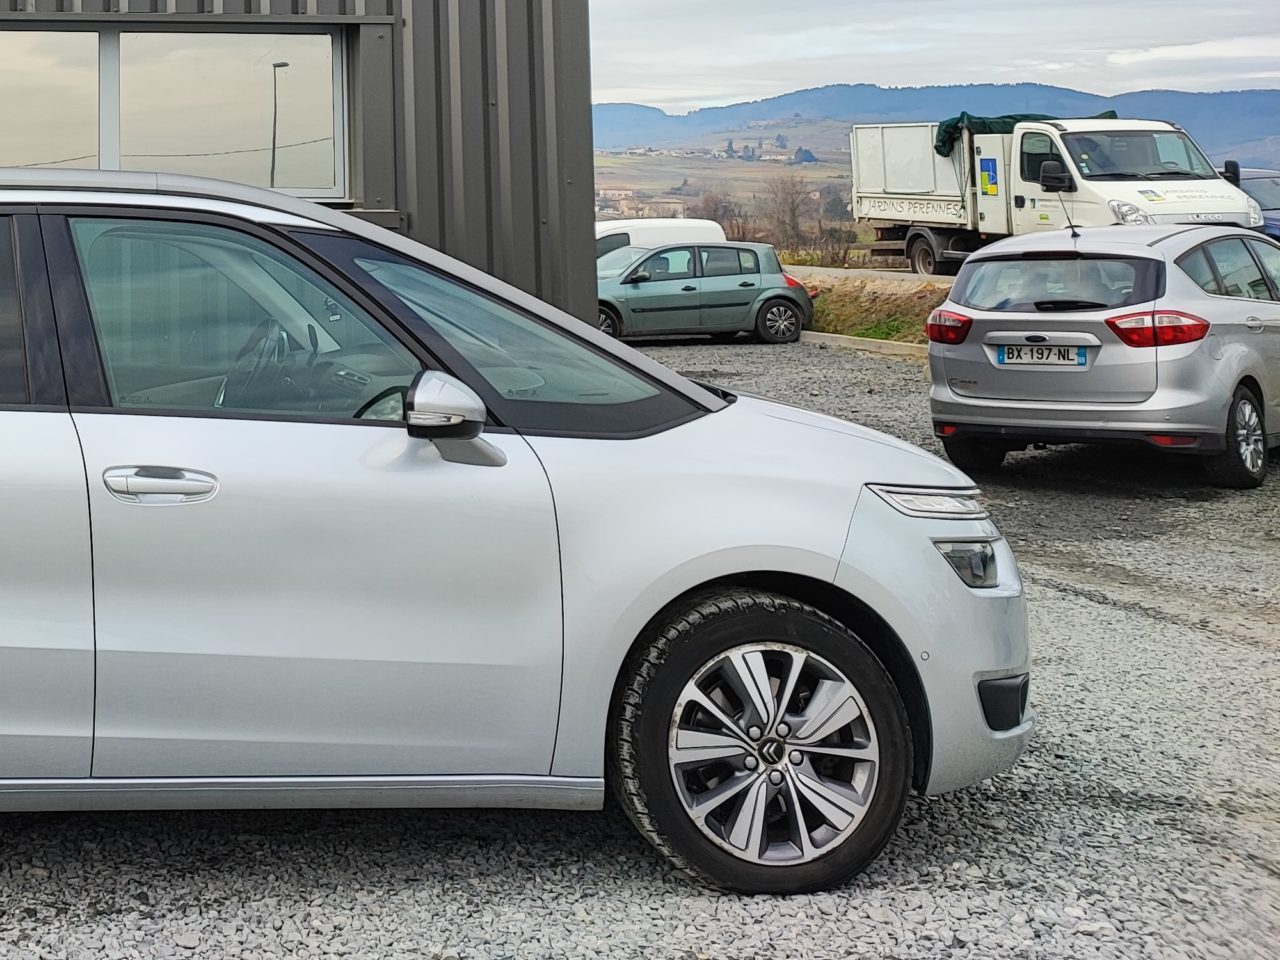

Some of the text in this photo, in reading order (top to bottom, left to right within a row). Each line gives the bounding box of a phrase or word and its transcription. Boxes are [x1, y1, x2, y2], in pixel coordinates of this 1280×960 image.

[864, 199, 959, 217] JARDINS PERENNES
[1188, 213, 1223, 222] IVECO
[1006, 346, 1076, 362] BX-197-NL
